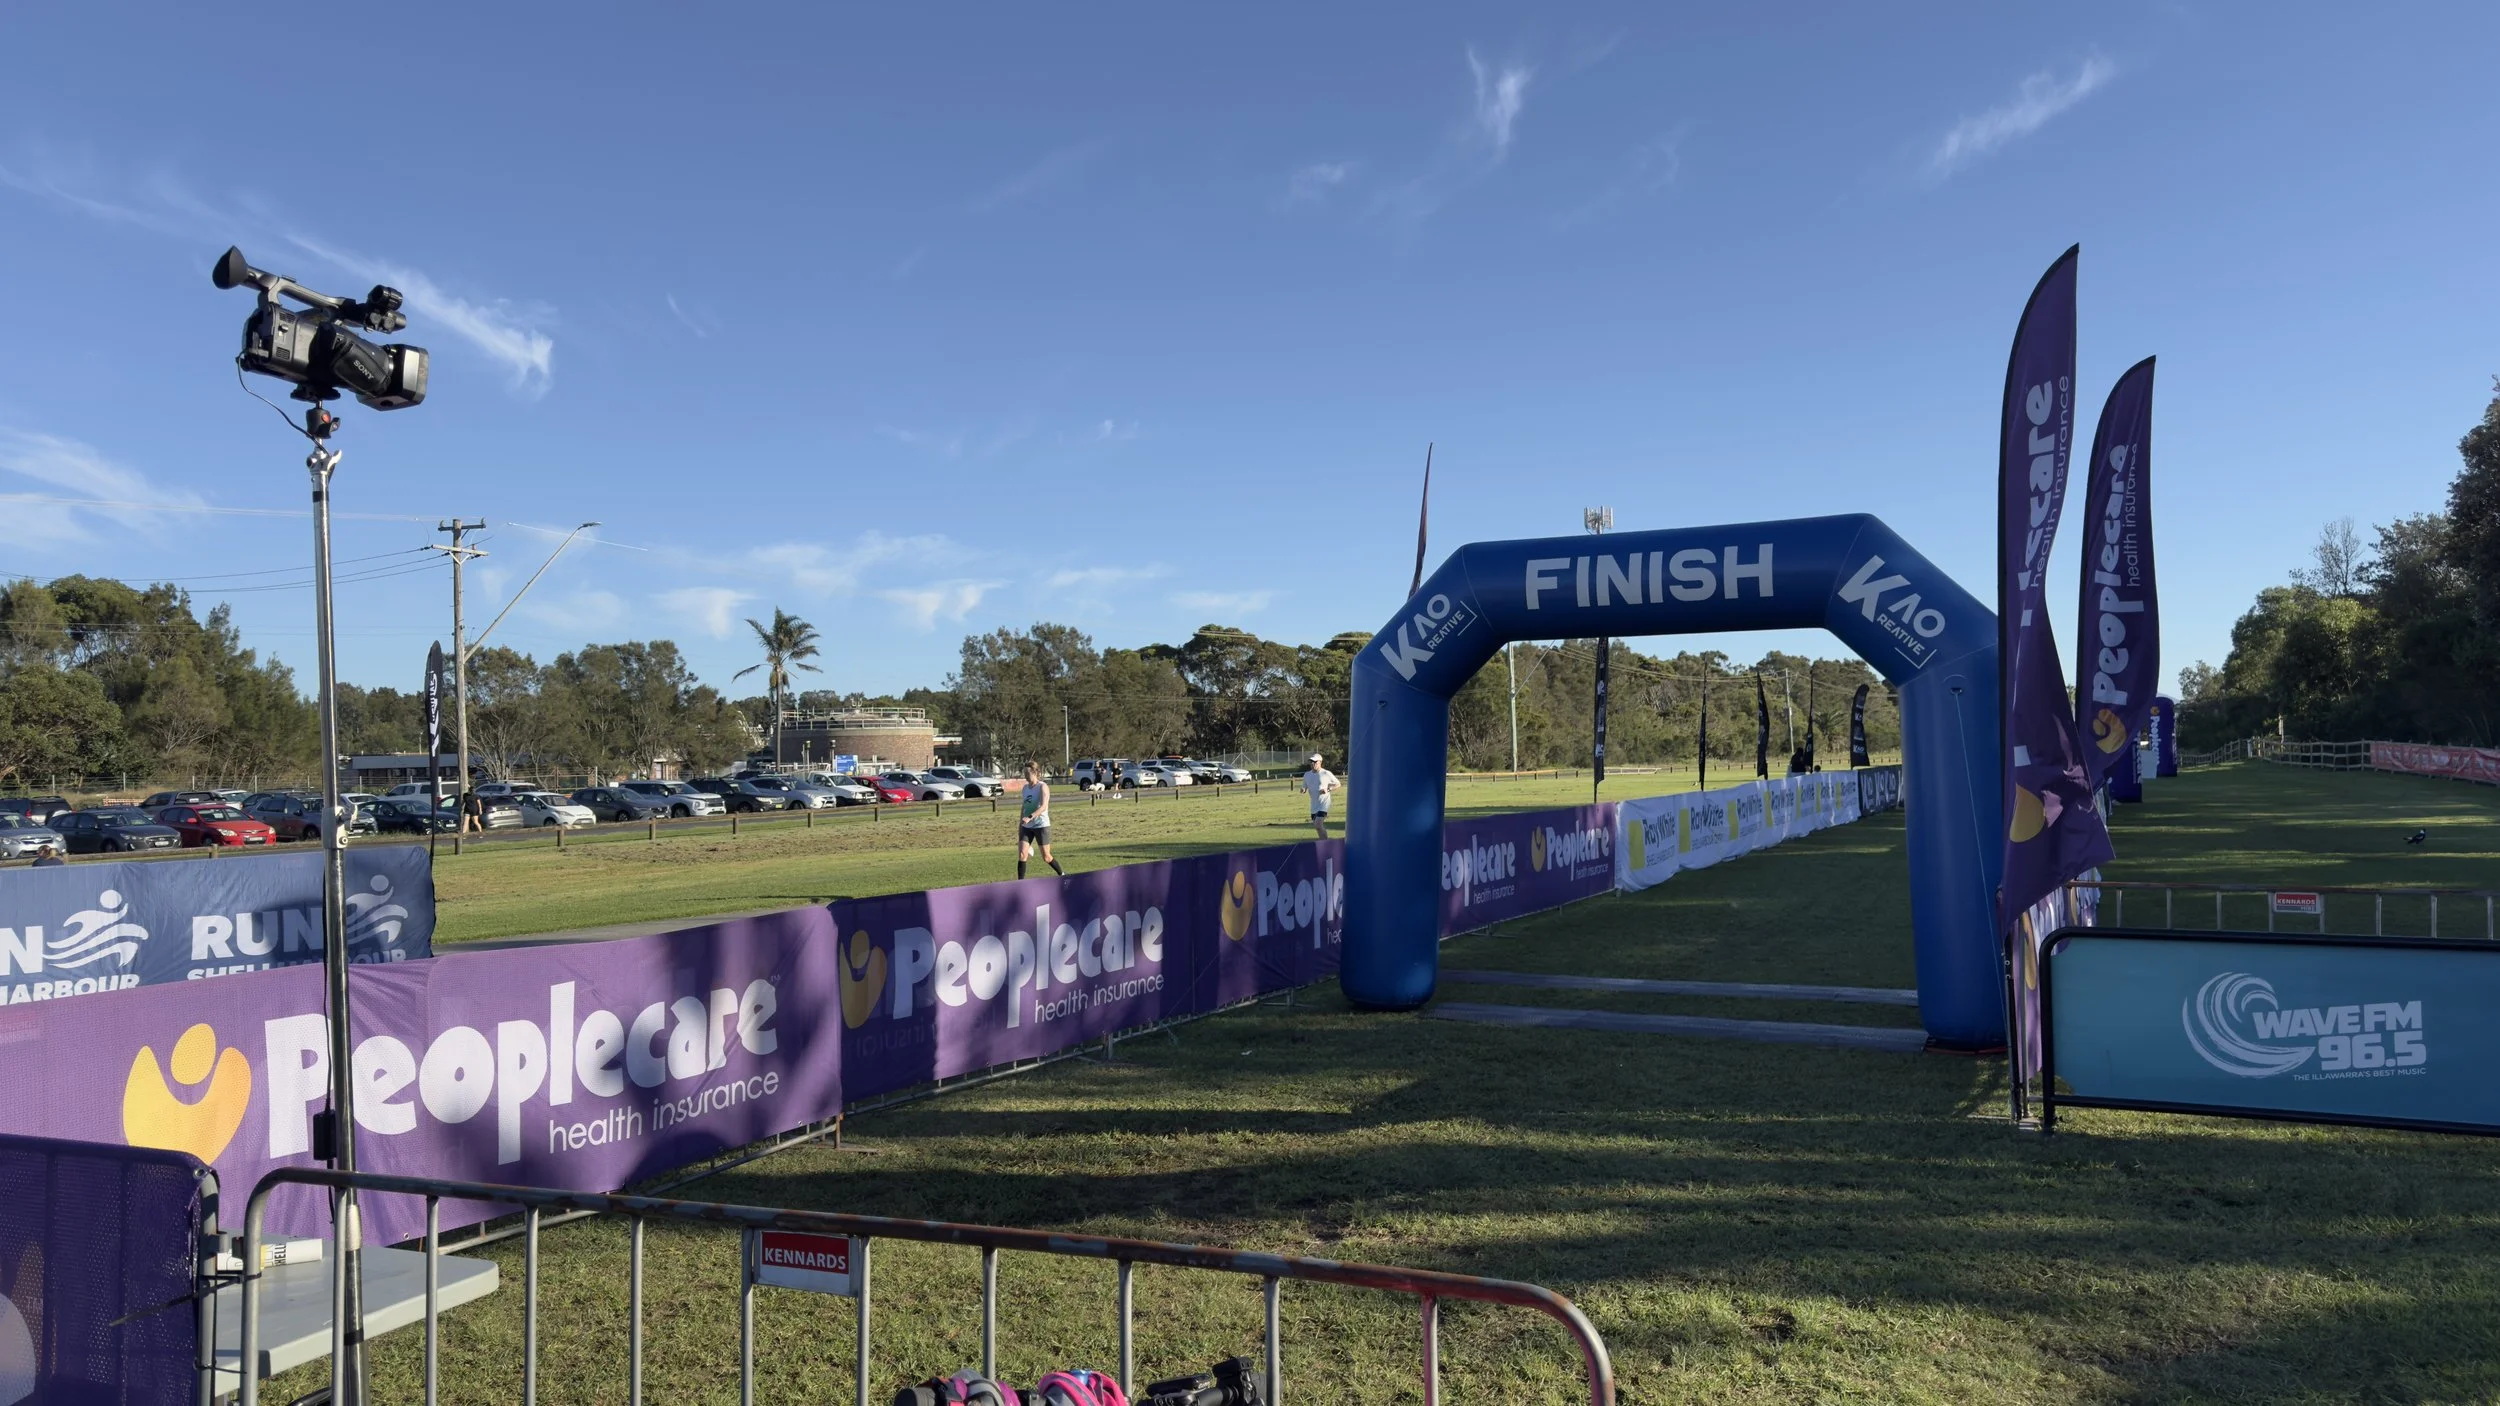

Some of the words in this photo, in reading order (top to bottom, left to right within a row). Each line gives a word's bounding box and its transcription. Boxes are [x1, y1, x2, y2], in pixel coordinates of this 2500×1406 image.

[353, 359, 374, 381] SONY
[2030, 507, 2056, 588] health
[2053, 375, 2069, 500] insurance
[1526, 543, 1774, 610] FINISH
[2092, 444, 2144, 706] Peoplecare
[2126, 533, 2142, 588] health
[1441, 834, 1516, 907] eoplecare
[1545, 820, 1609, 882] Peoplecare
[1256, 857, 1344, 949] People
[1473, 886, 1491, 905] health
[1492, 884, 1515, 899] insurance
[191, 908, 324, 961] RUN
[893, 904, 1164, 1029] Peoplecare
[1034, 993, 1088, 1023] health
[1094, 973, 1164, 1007] insurance
[2253, 1005, 2361, 1039] WAVE
[2363, 1001, 2422, 1031] FM
[265, 979, 778, 1165] Peoplecare
[2312, 1071, 2371, 1080] ILLAWARRA'S
[2373, 1069, 2395, 1077] BEST
[2397, 1067, 2427, 1076] MUSIC
[2318, 1030, 2427, 1070] 96.5
[550, 1106, 642, 1153] health
[652, 1071, 780, 1131] insurance
[765, 1247, 846, 1270] KENNARDS
